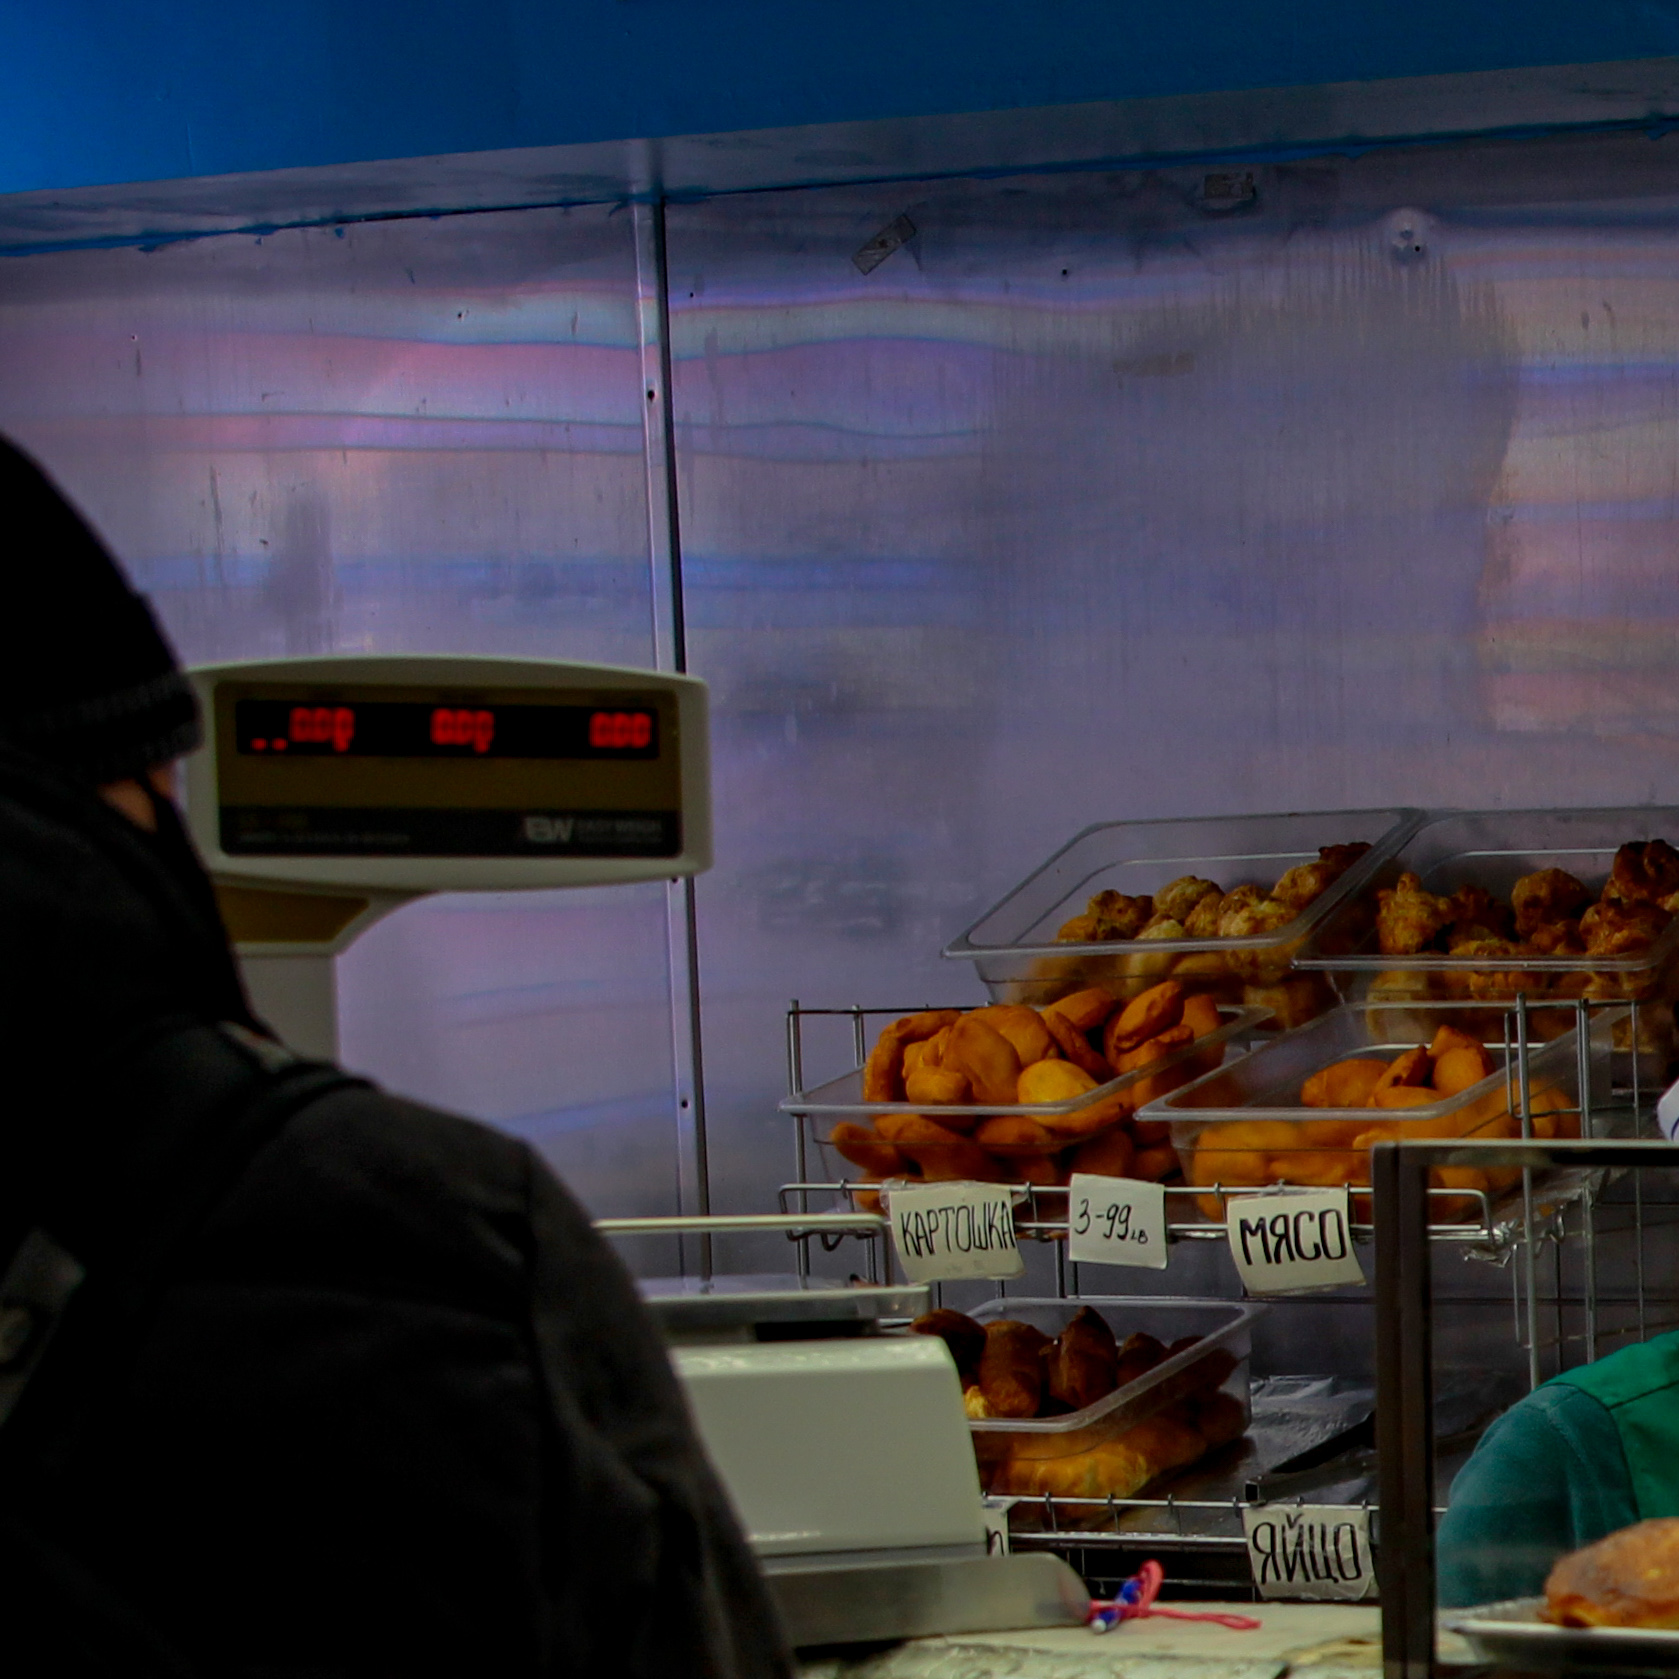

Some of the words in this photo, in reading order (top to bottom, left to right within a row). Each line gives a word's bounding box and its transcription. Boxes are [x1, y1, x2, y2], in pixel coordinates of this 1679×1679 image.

[900, 1201, 1017, 1258] КАРТОШКА
[1240, 1209, 1347, 1265] МЯСО
[1252, 1512, 1362, 1584] ЯЙЦО
